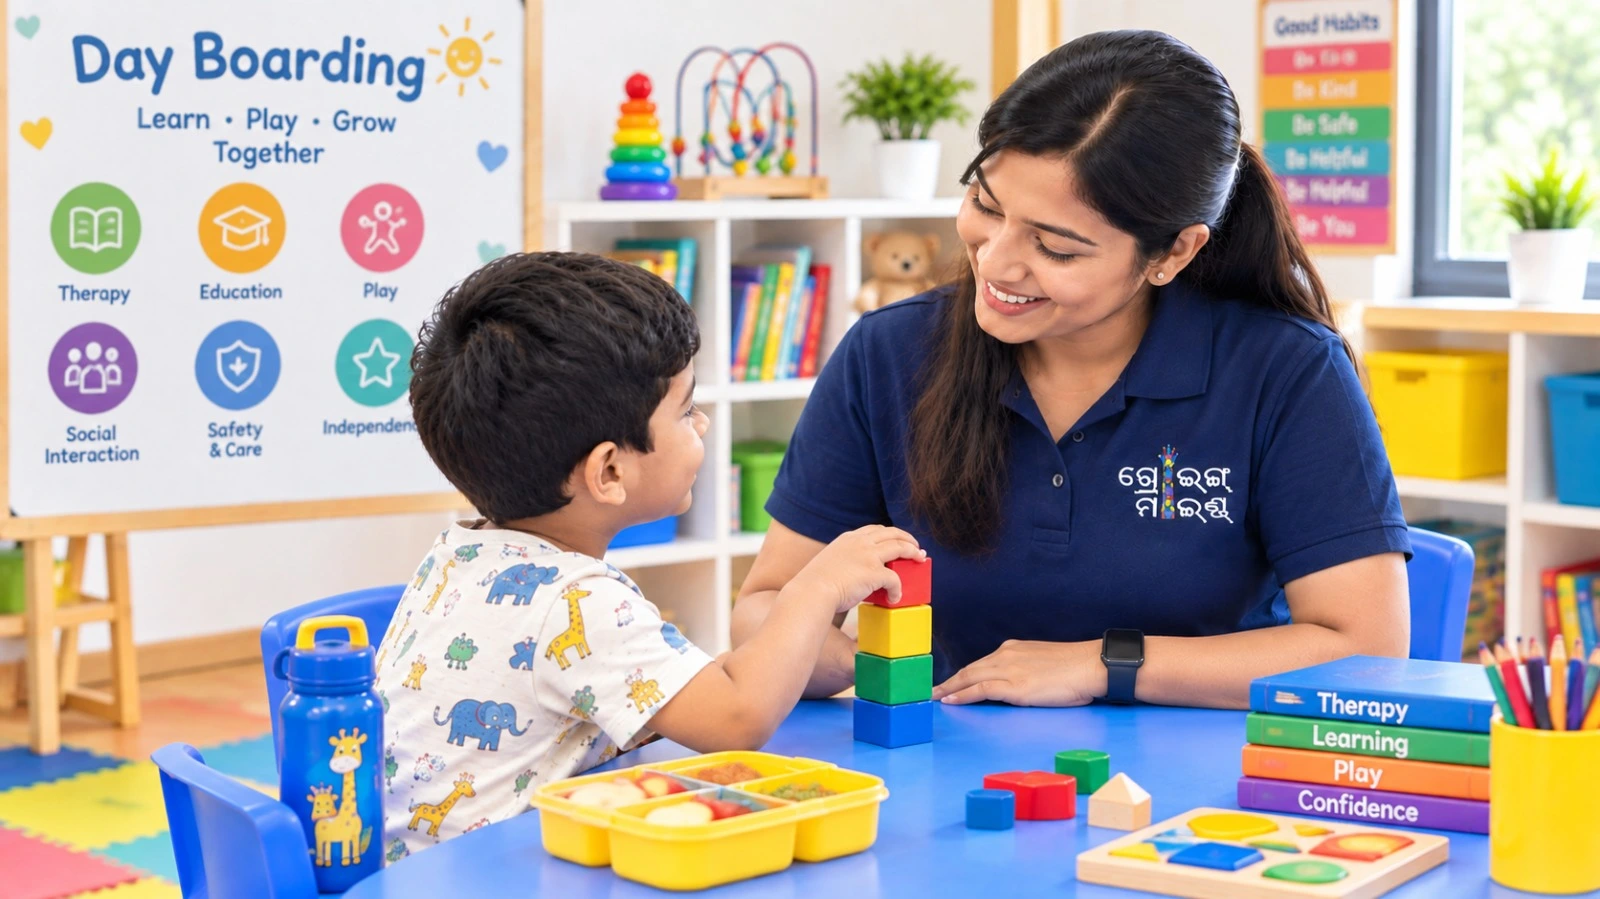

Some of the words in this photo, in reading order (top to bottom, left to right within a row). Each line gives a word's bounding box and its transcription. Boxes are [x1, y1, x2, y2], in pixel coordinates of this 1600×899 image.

[1274, 15, 1319, 37] Good
[72, 34, 174, 96] Day
[193, 31, 425, 103] Boarding
[138, 107, 210, 129] Learn
[247, 107, 298, 137] Play
[333, 110, 397, 132] Grow
[1292, 113, 1315, 136] Be
[1318, 112, 1358, 135] Safe
[213, 141, 325, 169] Together
[1285, 147, 1307, 170] Be
[1309, 146, 1369, 171] Helpful
[1309, 178, 1369, 204] Helpful
[1322, 214, 1357, 238] You
[58, 285, 130, 305] Therapy
[200, 283, 282, 300] Education
[364, 282, 398, 302] Play
[67, 425, 116, 442] Social
[208, 421, 262, 440] Safety
[323, 417, 418, 437] Independenc
[46, 446, 139, 464] Interaction
[210, 443, 221, 458] &
[226, 442, 262, 457] Care
[1317, 692, 1409, 723] Therapy
[1313, 725, 1409, 758] Learning
[1334, 760, 1383, 788] Play
[1298, 790, 1418, 822] Confidence
